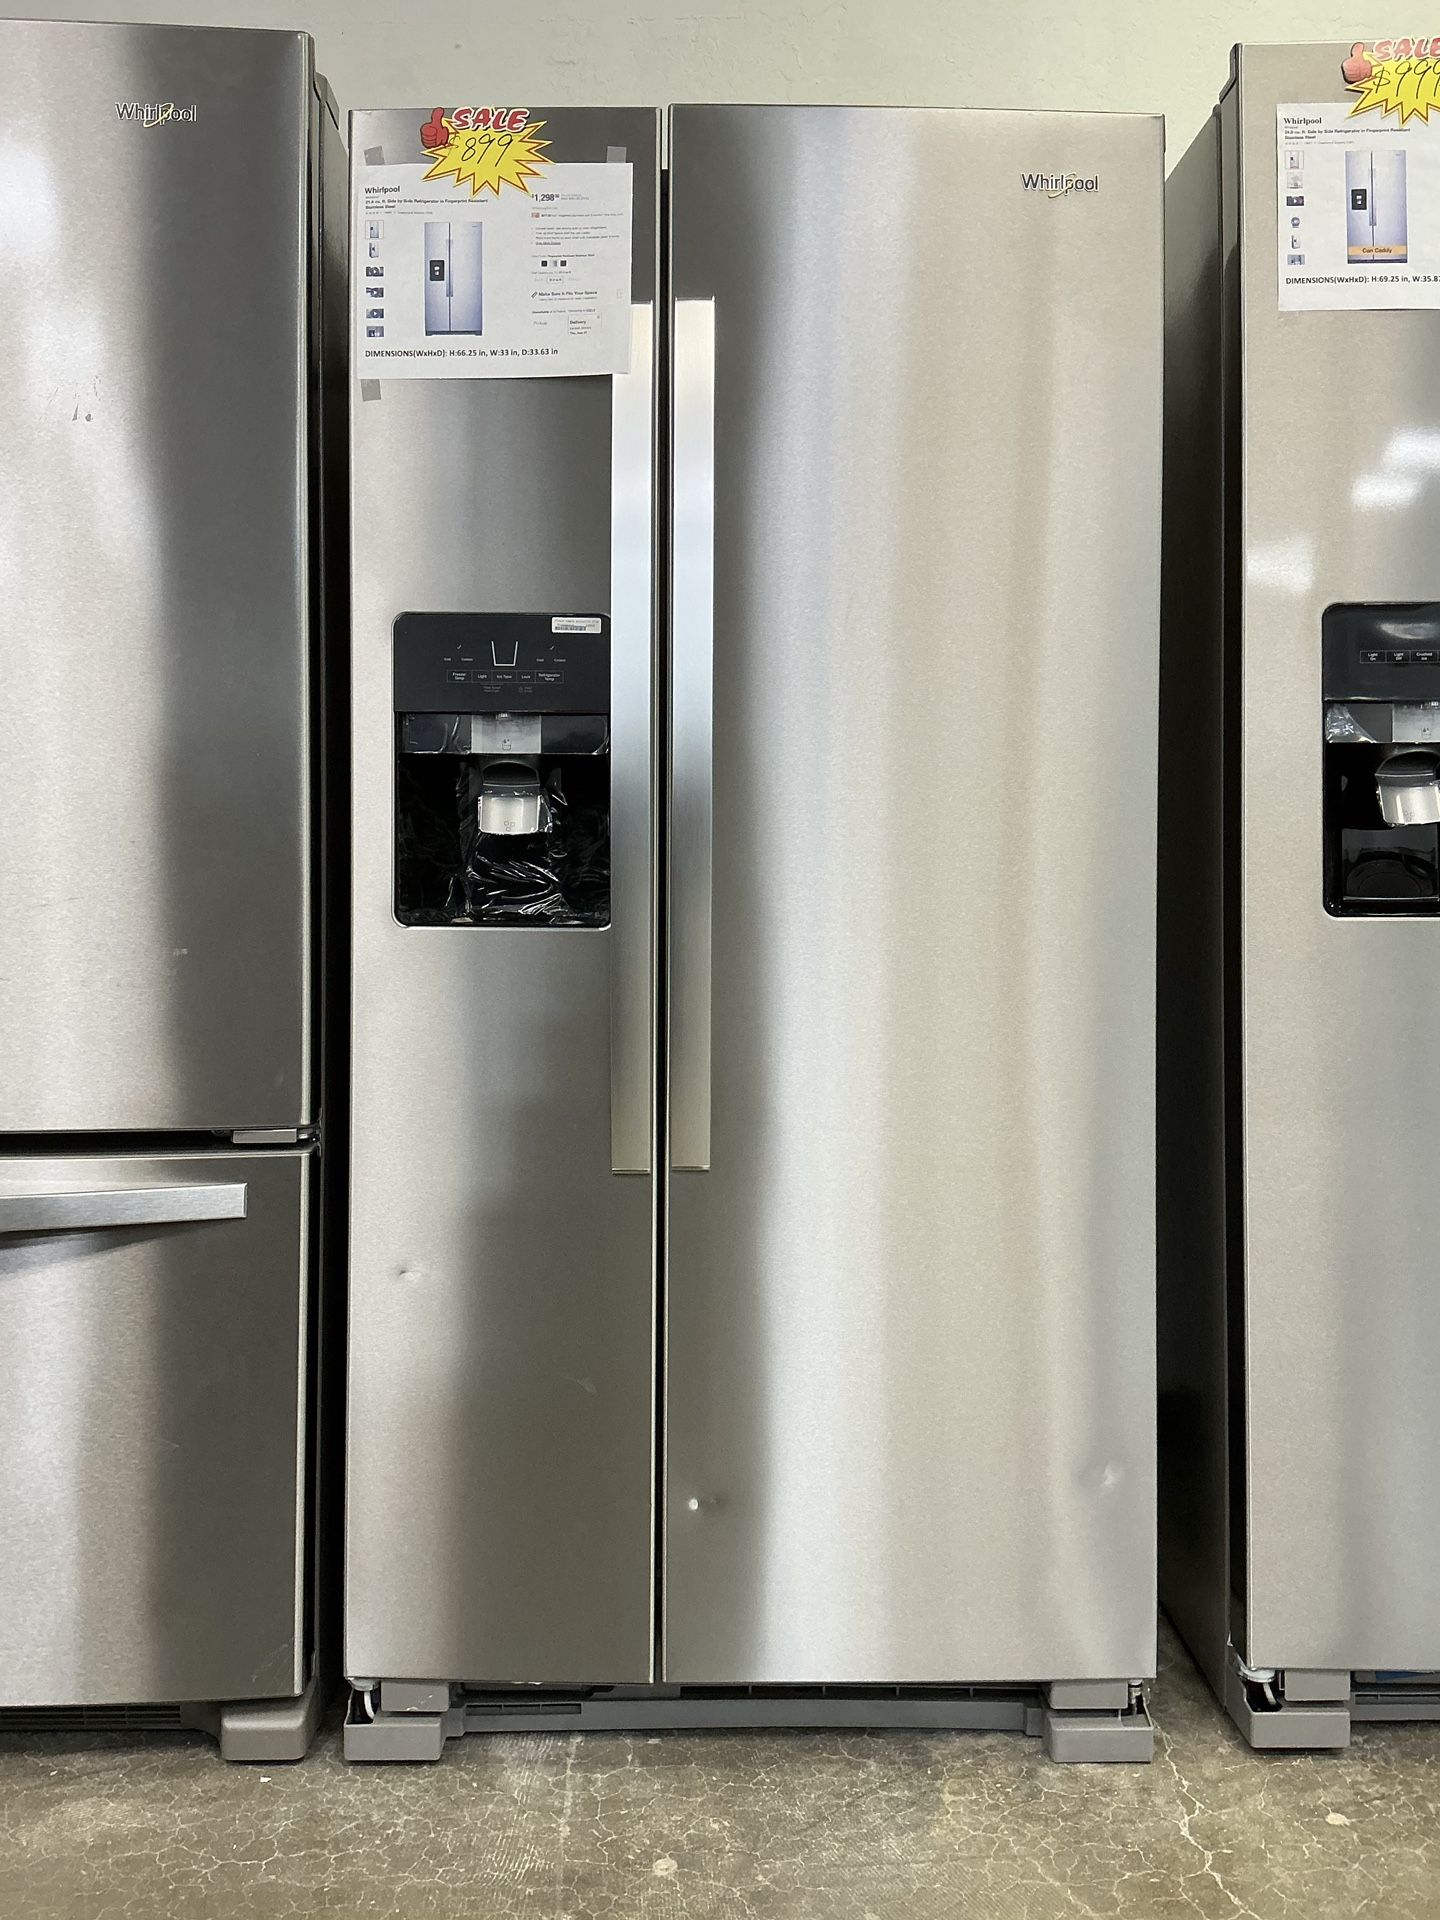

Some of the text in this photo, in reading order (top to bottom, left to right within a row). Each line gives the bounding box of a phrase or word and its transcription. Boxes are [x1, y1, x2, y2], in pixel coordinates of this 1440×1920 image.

[115, 102, 197, 126] Whirlpool
[453, 107, 529, 132] SALE
[1284, 117, 1322, 126] Whirlpool
[1020, 173, 1099, 197] Whirlpool
[364, 186, 401, 195] Whirlpool
[1286, 276, 1370, 285] DIMENSIONS(WxHxD):
[1371, 275, 1400, 283] H:69.25
[365, 349, 448, 358] DIMENSIONS(WxHxD):
[449, 349, 478, 357] H:66.25
[479, 349, 488, 358] in,
[490, 349, 509, 357] W:33
[510, 349, 520, 357] in,
[521, 348, 550, 356] D:33.63
